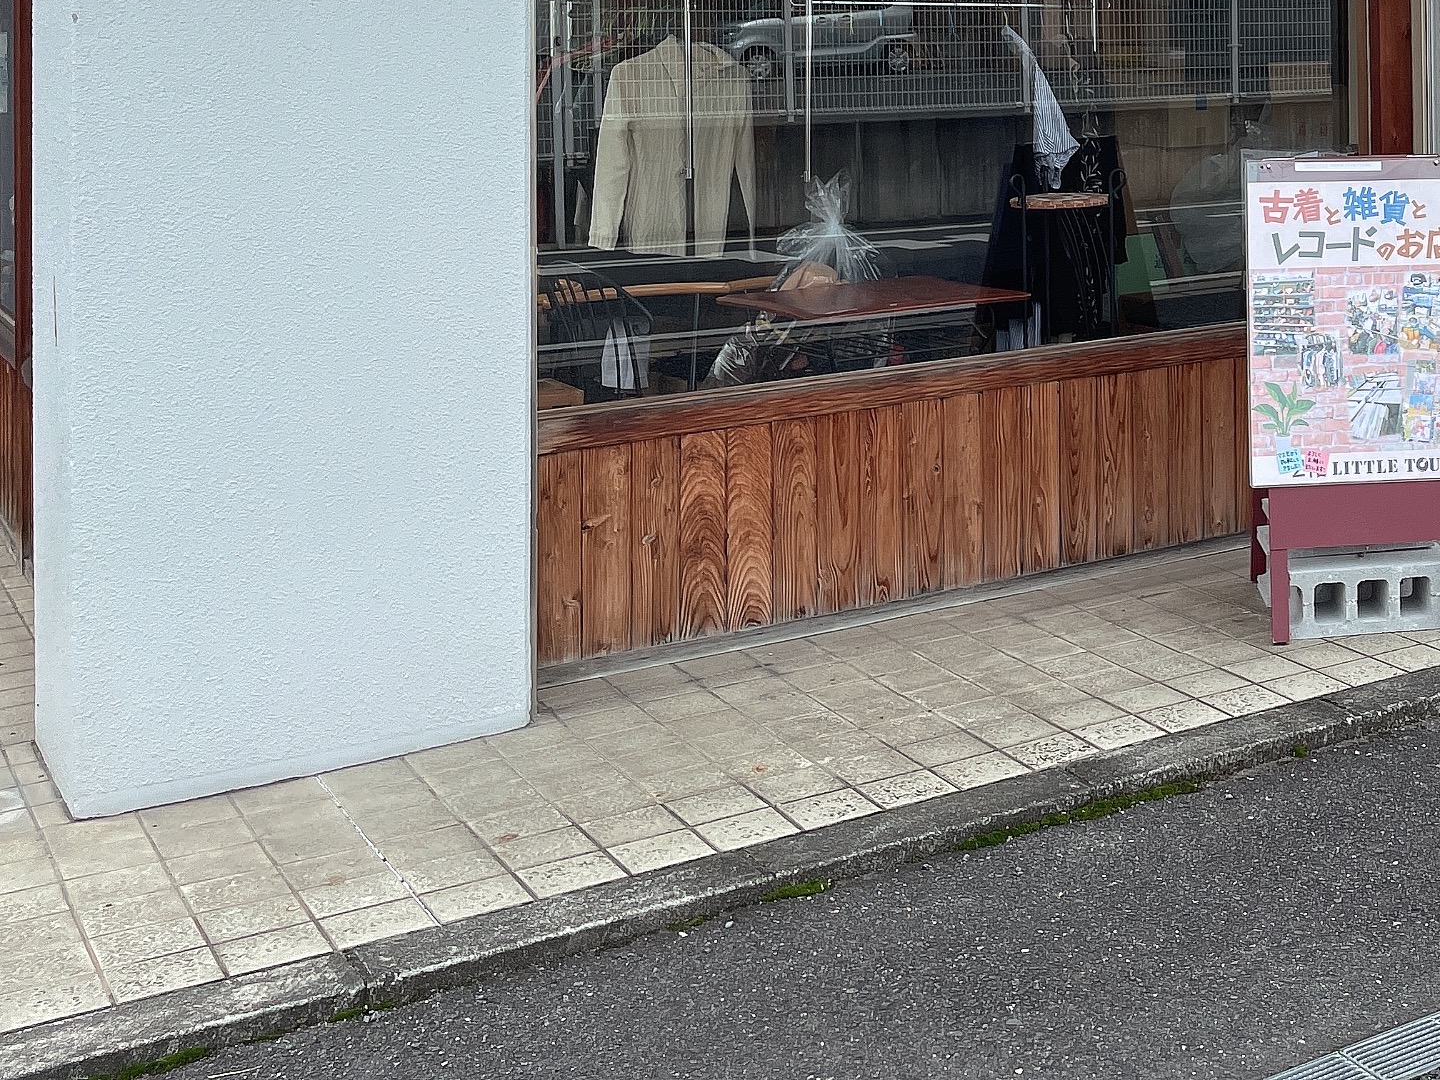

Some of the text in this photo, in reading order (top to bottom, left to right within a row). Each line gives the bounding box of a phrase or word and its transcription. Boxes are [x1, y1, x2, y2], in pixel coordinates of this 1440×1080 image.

[1259, 187, 1426, 226] 古着と雑貨と
[1332, 459, 1398, 476] LITTLE
